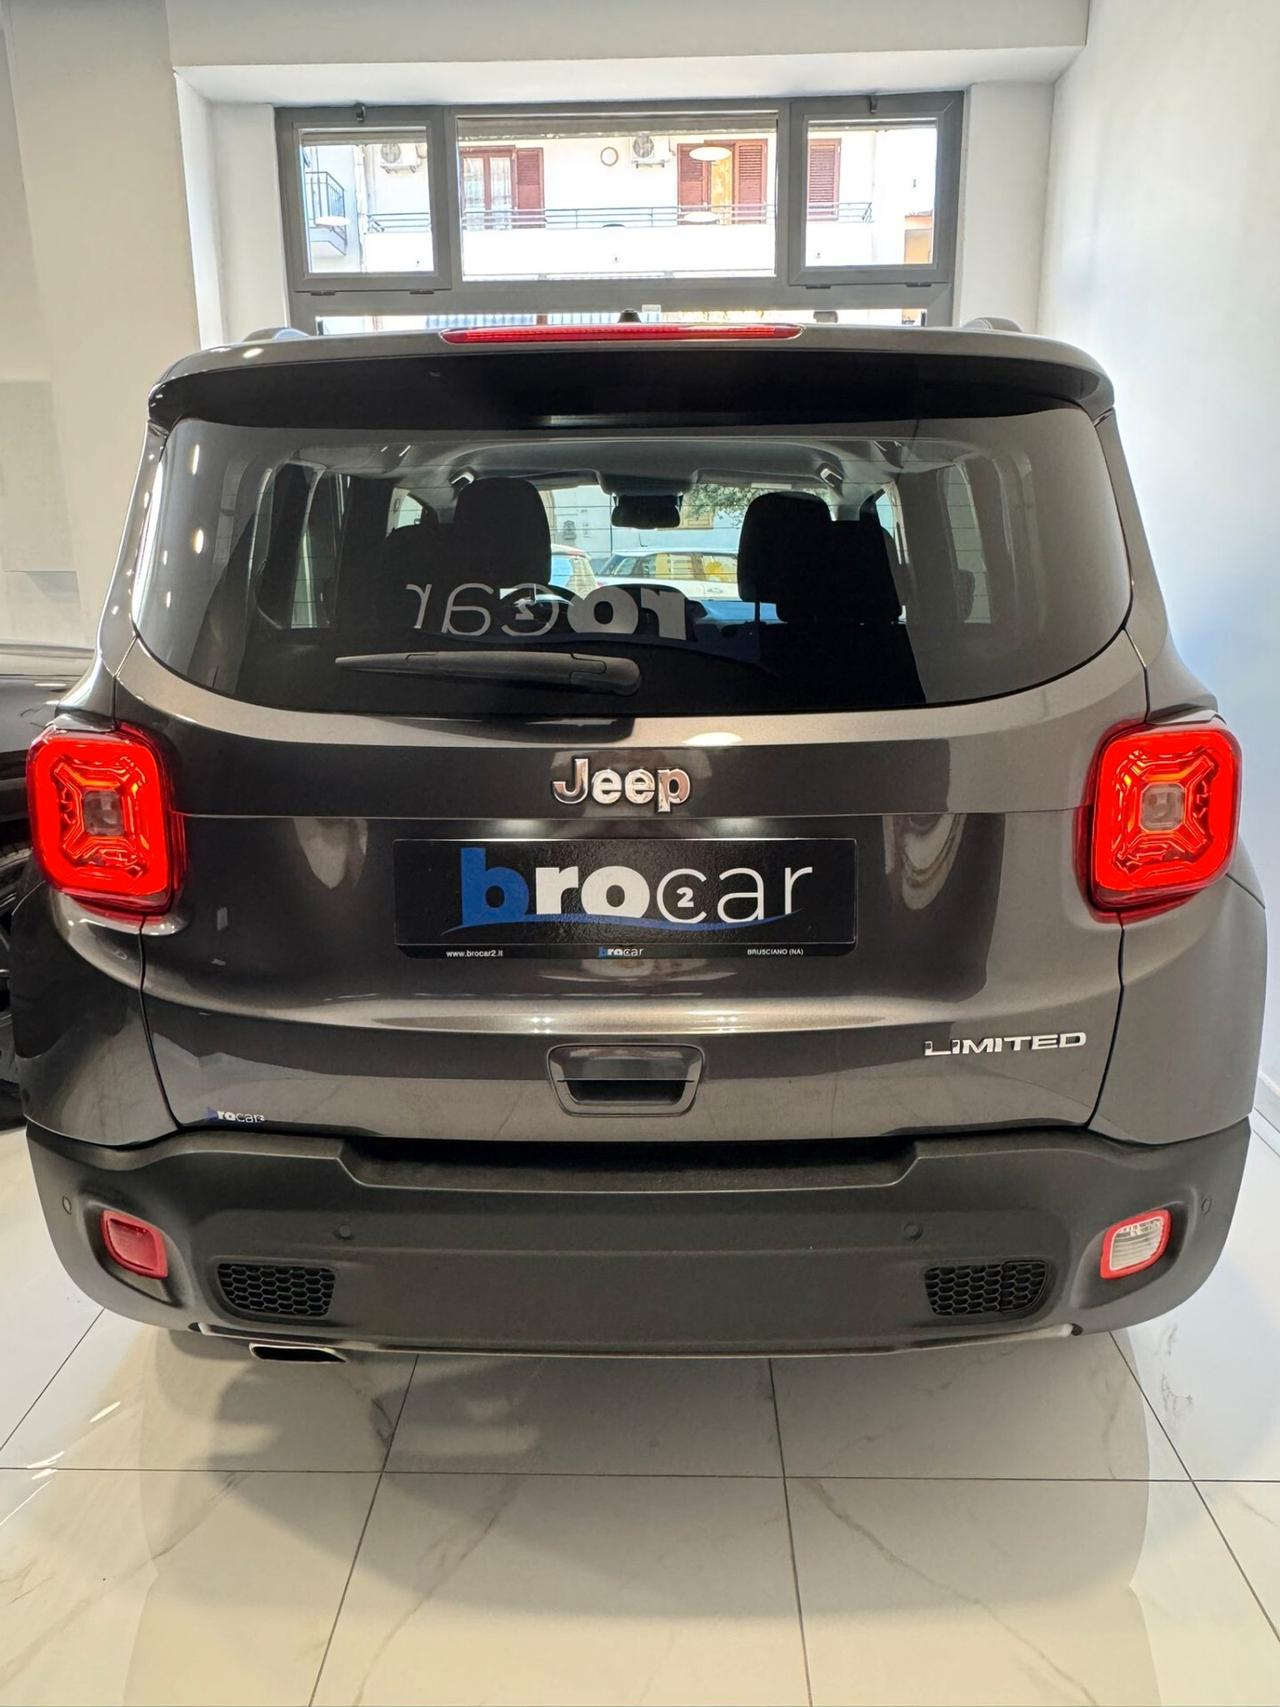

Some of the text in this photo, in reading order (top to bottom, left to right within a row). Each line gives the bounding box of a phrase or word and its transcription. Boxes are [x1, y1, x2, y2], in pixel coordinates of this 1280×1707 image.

[552, 756, 692, 813] Jeep
[445, 949, 504, 958] www.brocar2.it
[747, 948, 804, 956] BRUSCIANO (NA)
[924, 1031, 1088, 1057] LIMITED
